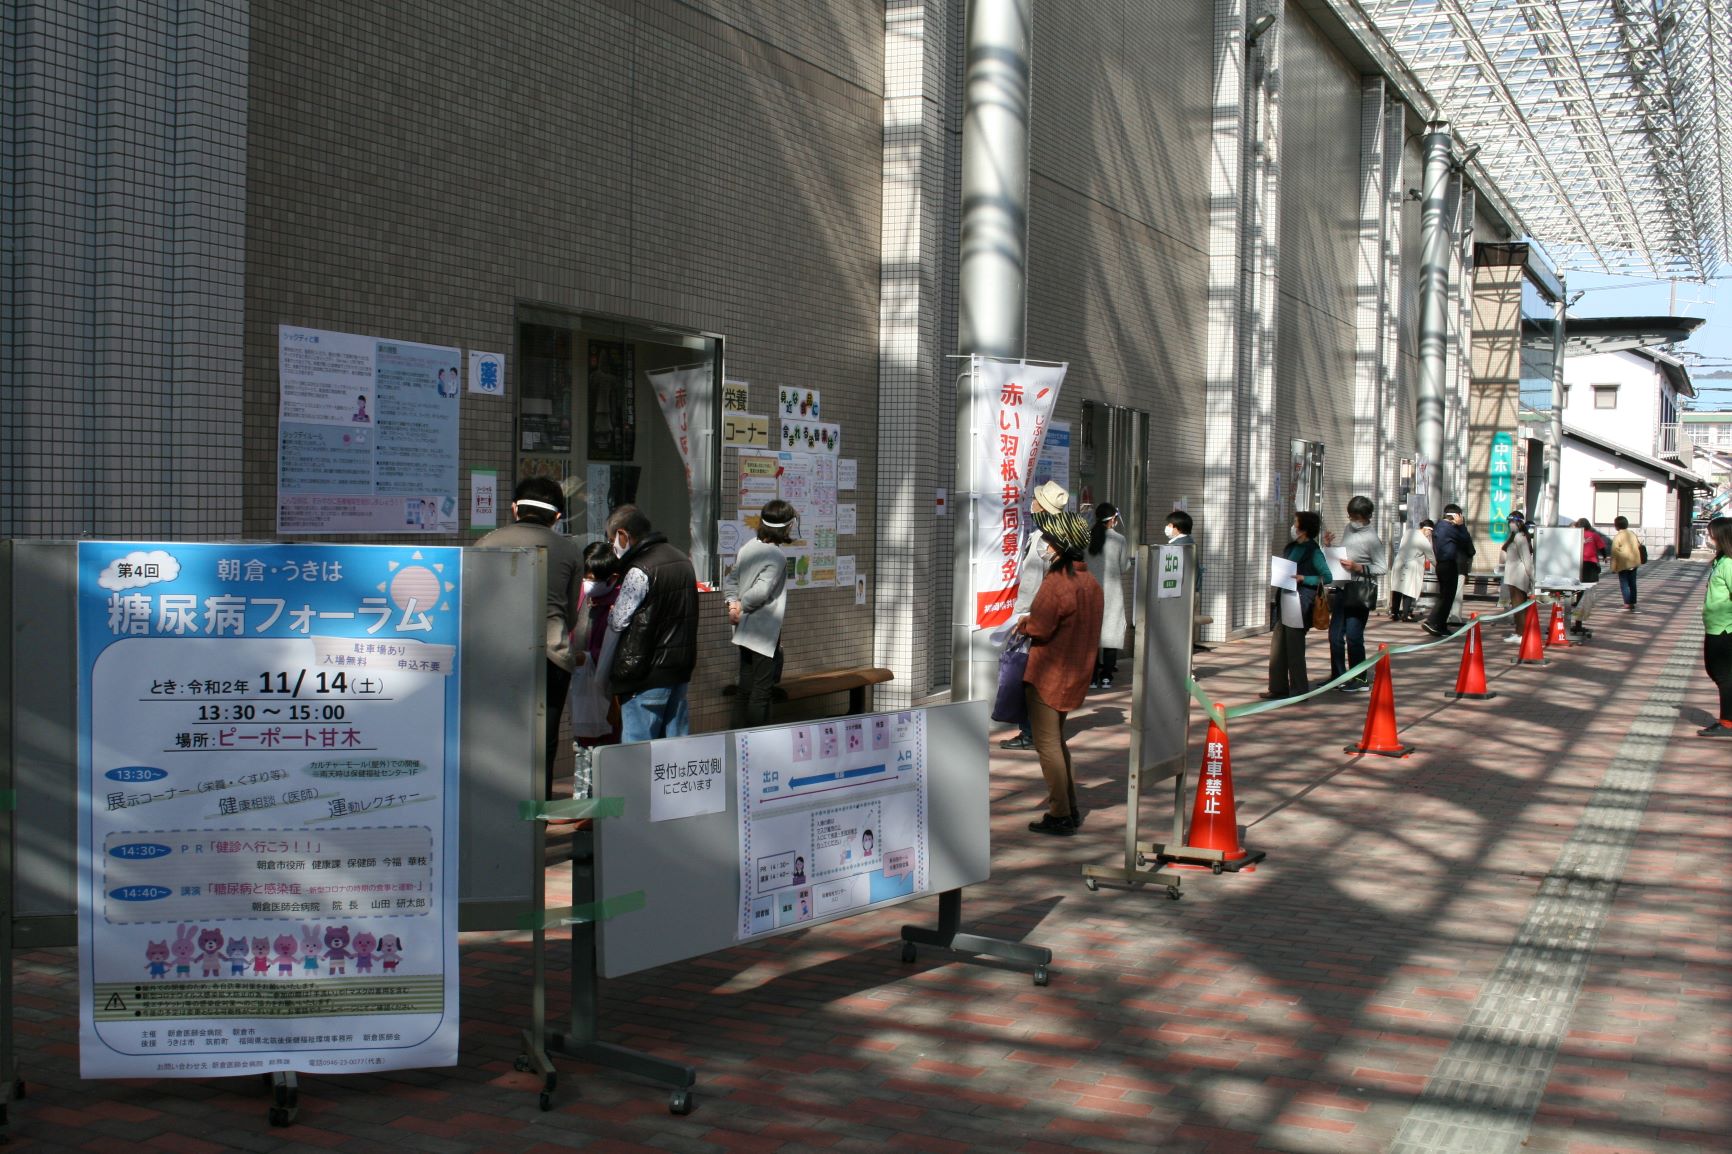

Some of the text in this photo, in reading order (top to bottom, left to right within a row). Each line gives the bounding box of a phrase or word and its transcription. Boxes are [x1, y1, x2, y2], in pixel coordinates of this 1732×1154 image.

[480, 361, 498, 390] 薬
[724, 388, 747, 412] 栄養
[725, 422, 767, 443] コーナー
[1000, 383, 1024, 582] 赤い羽根共同募金
[1493, 442, 1508, 534] 中ホール入口
[117, 562, 160, 579] 第4回
[216, 558, 343, 582] 朝倉・うきは
[107, 592, 433, 636] 糖尿病フォーラム
[353, 642, 407, 656] 駐車場あり
[323, 654, 441, 672] 入場無料 申込不要
[150, 679, 250, 696] とき：令和2年
[176, 728, 361, 748] 場所：ピーポート甘木
[897, 750, 913, 762] 入口
[116, 769, 163, 781] 13:30～
[654, 757, 722, 782] 受付は反対側
[762, 771, 779, 783] 出口
[663, 779, 713, 795] にございます
[1204, 742, 1224, 815] 駐車禁止
[219, 787, 320, 817] 健康相談（医師）
[328, 791, 420, 818] 運動レクチャー
[121, 846, 165, 857] 14:30～
[256, 860, 305, 870] 朝倉市役所
[312, 859, 341, 870] 健康課
[347, 857, 376, 868] 保健師
[122, 887, 167, 898] 14:40～
[252, 901, 321, 912] 朝倉医師会病院
[371, 900, 391, 909] 山田
[397, 897, 426, 909] 研太郎
[232, 1027, 257, 1037] 朝倉市
[167, 1038, 195, 1047] うきは市
[157, 1062, 209, 1071] お問い合わせ先
